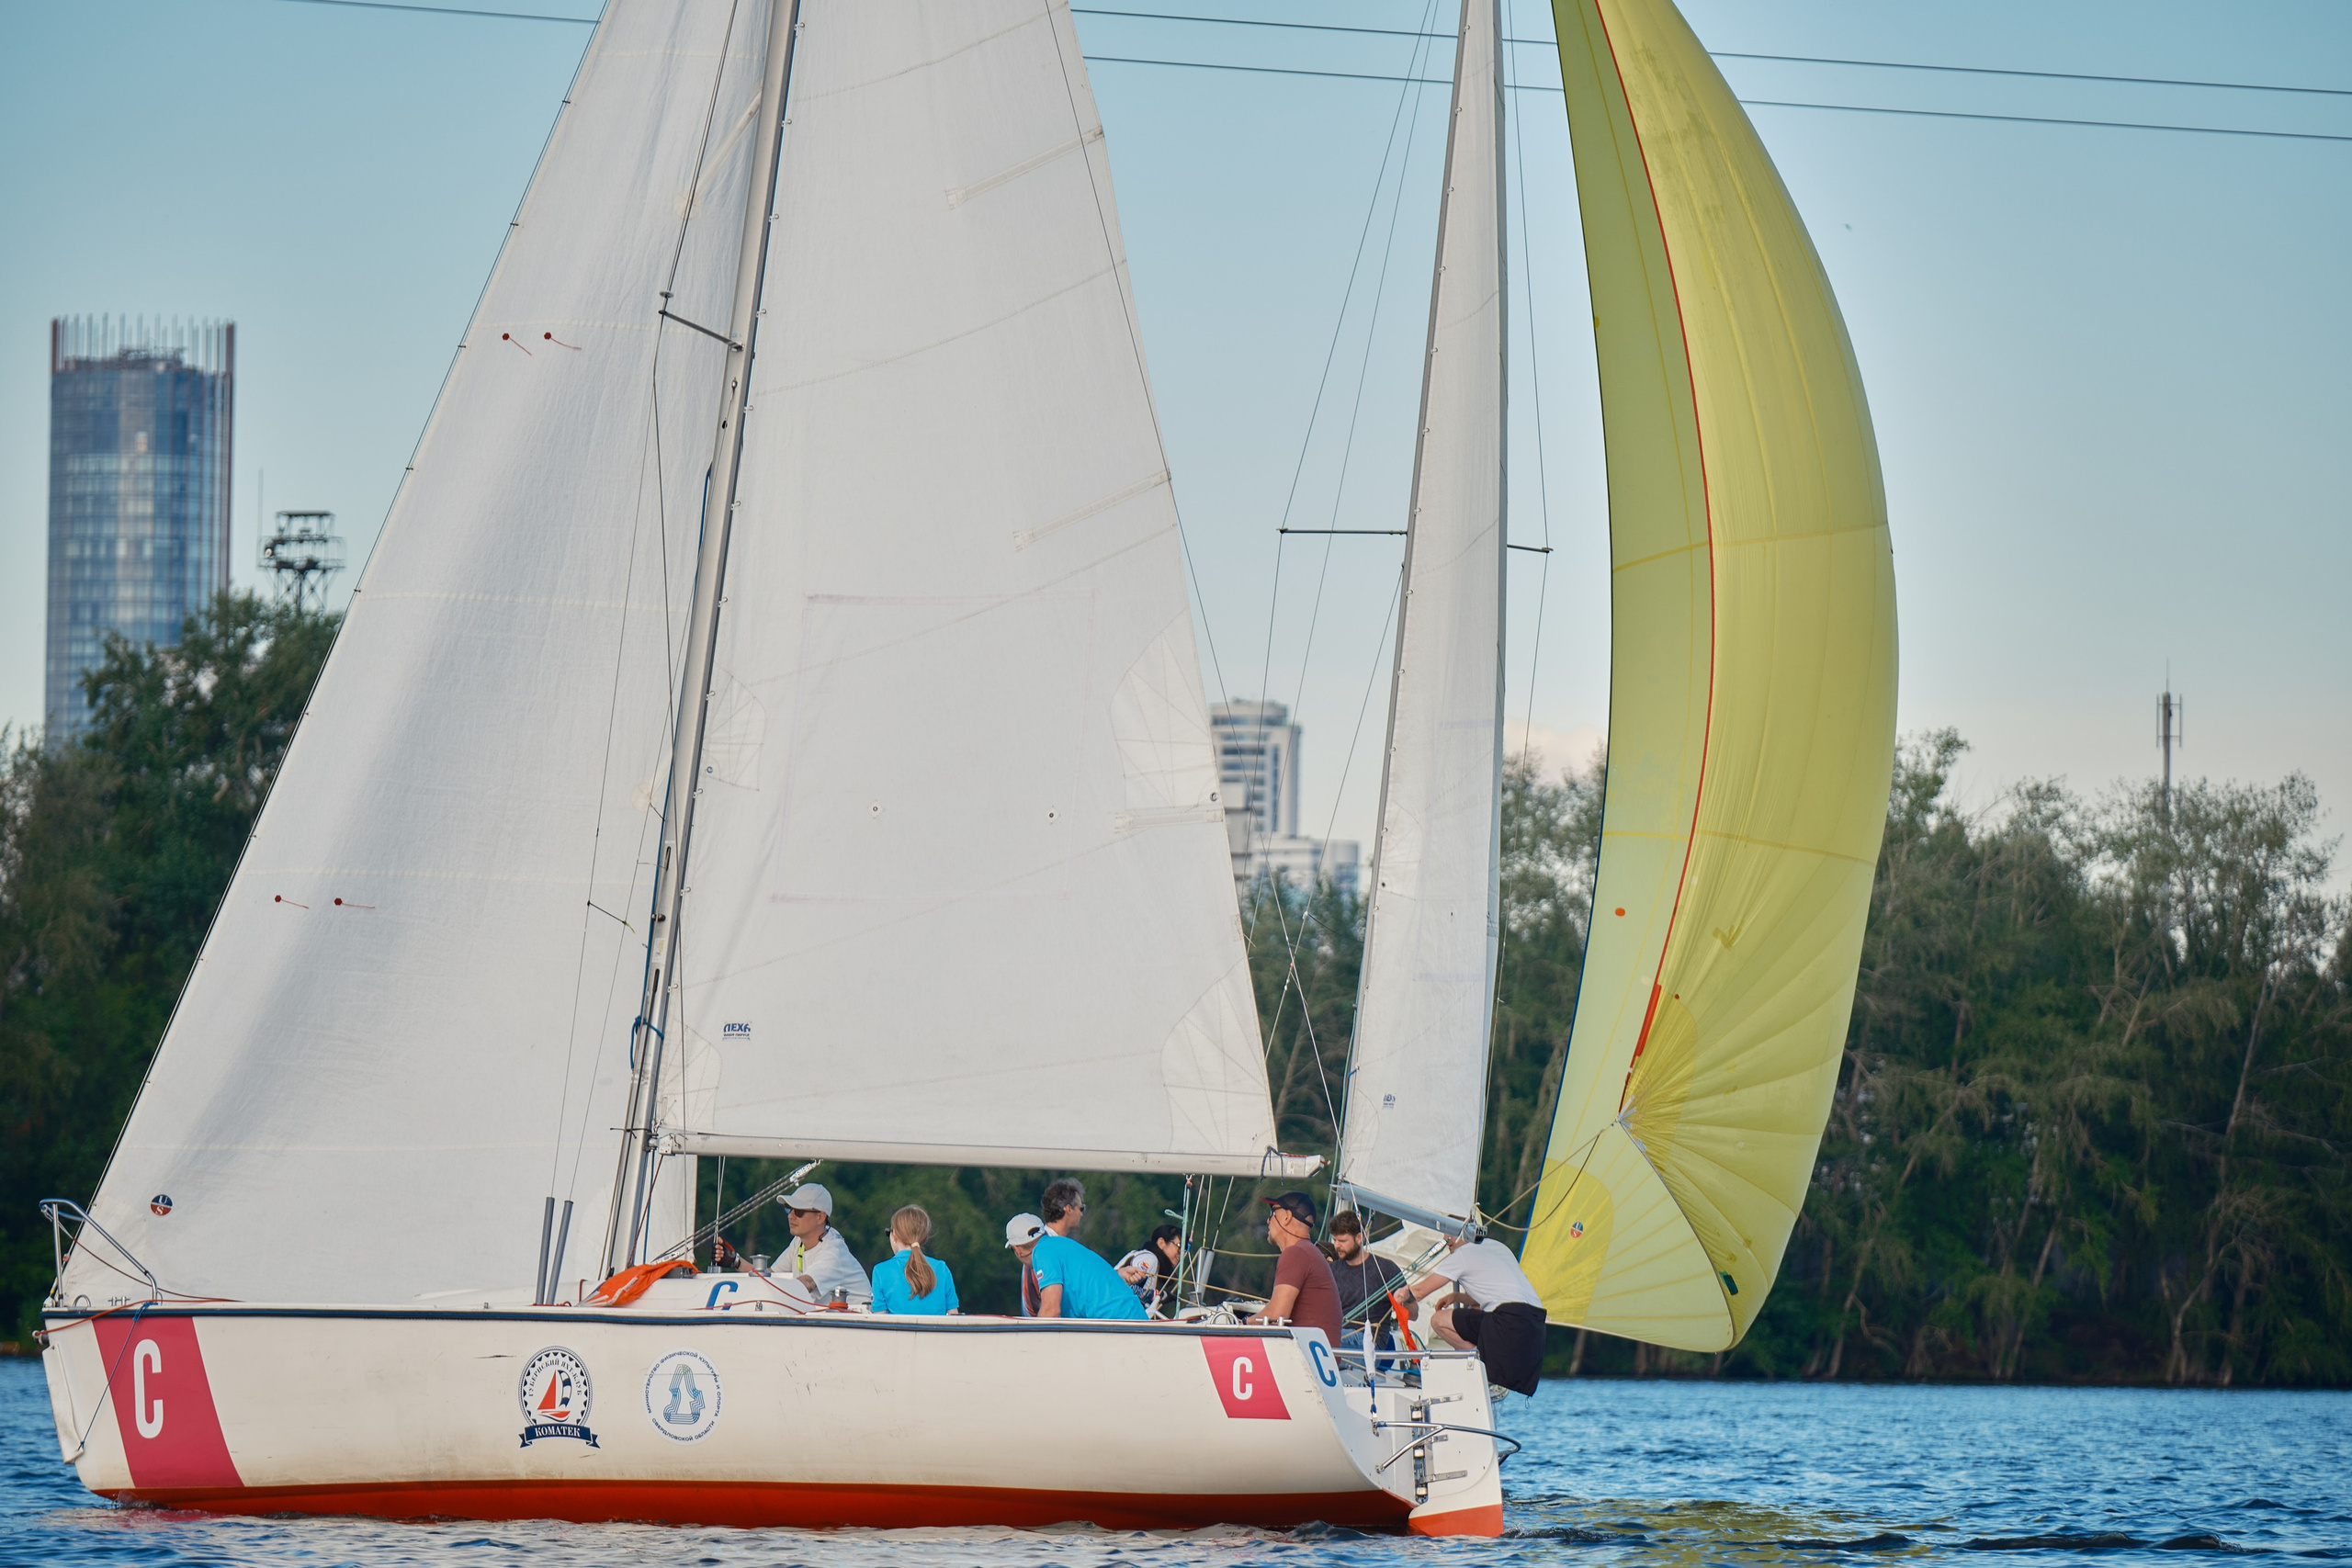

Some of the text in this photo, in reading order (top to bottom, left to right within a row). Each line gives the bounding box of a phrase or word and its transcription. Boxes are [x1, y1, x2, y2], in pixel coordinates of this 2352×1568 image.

[528, 1358, 582, 1396] ГУБЕРНСКИЙ ЯХТ-КЛУБ
[645, 1363, 661, 1414] МИНИСТЕРСТВО
[660, 1350, 698, 1364] ФИЗИЧЕСКОЙ
[698, 1357, 718, 1383] КУЛЬТУРЫ
[1232, 1356, 1253, 1400] C
[1308, 1340, 1337, 1387] C
[133, 1338, 164, 1439] C
[535, 1426, 581, 1438] КОМАТЕК
[651, 1417, 716, 1442] СВЕРДЛОВСКОЙ ОБЛАСТИ
